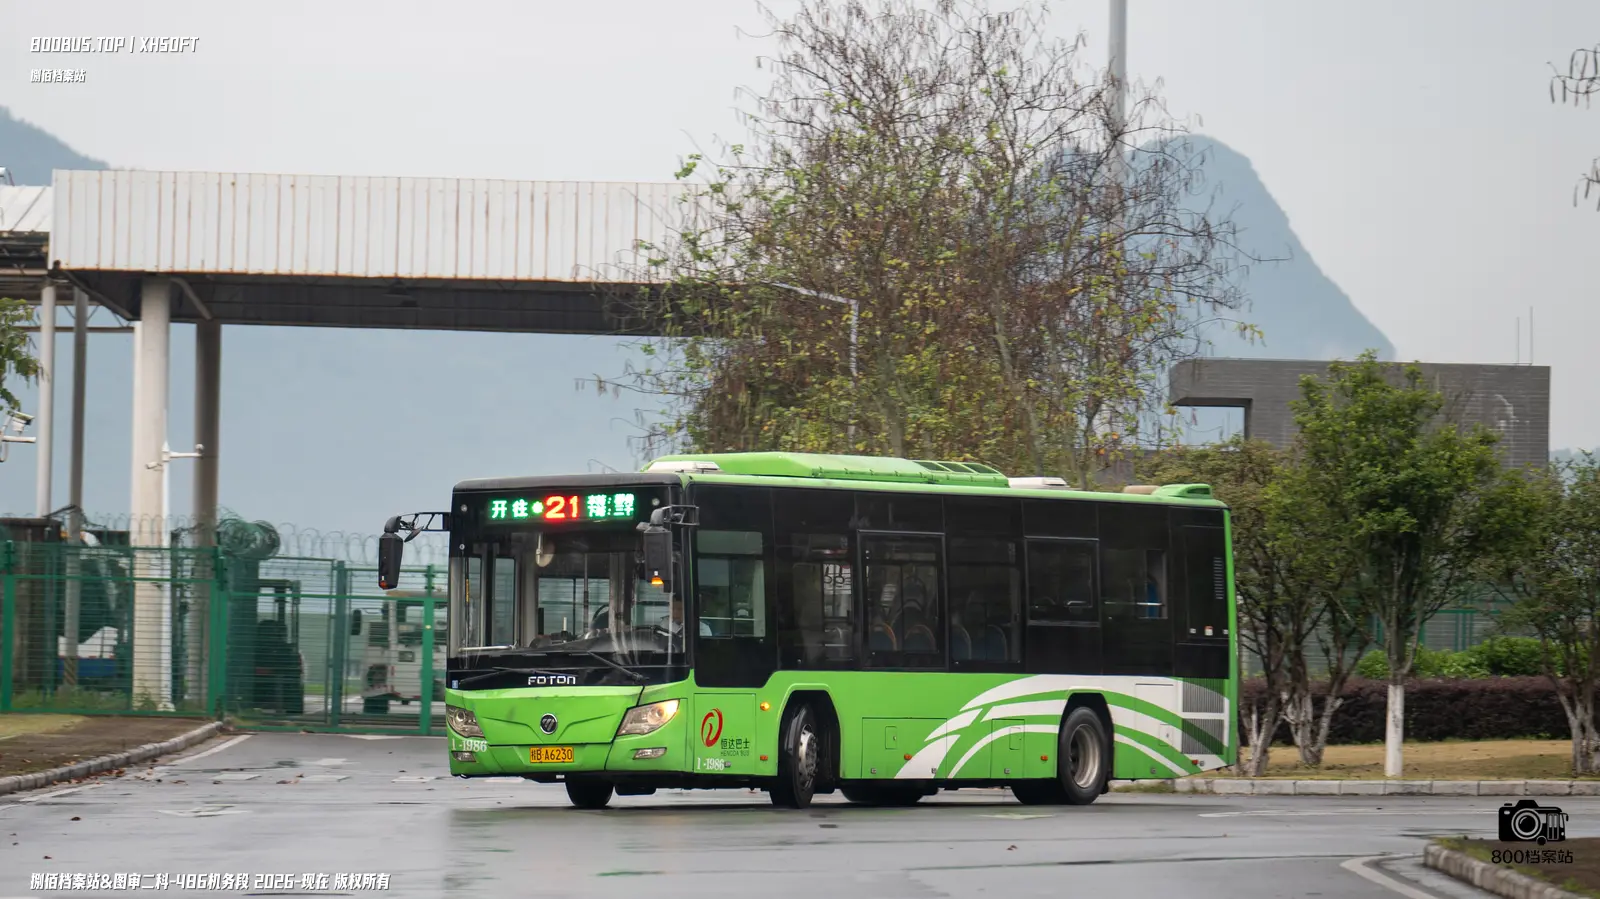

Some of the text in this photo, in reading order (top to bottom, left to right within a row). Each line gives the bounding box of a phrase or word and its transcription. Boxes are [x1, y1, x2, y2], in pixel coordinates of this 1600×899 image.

[491, 498, 529, 519] 开往
[544, 494, 580, 519] 21
[527, 675, 577, 686] FOTON
[720, 737, 751, 750] 恒达巴士
